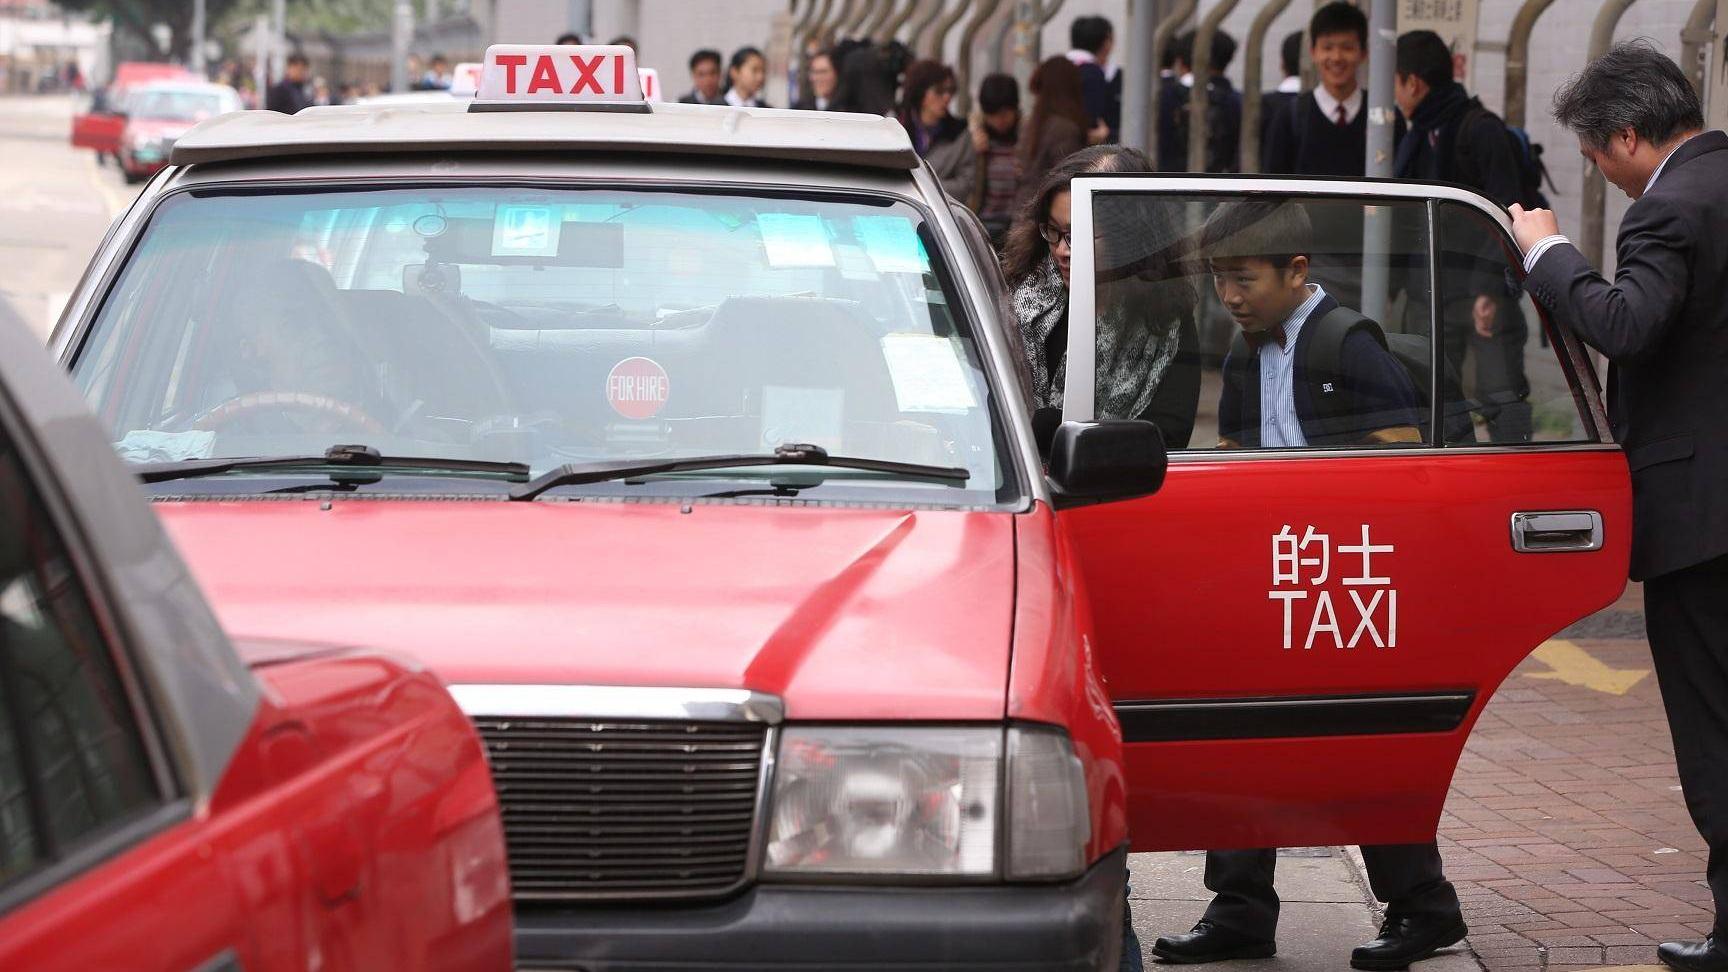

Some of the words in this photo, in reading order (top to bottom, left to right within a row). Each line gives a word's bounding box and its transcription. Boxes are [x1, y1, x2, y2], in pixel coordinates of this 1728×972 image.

[495, 55, 624, 95] TAXI
[610, 375, 634, 401] FOR
[636, 375, 665, 401] HIRE
[1272, 524, 1394, 586] 的士
[1268, 589, 1397, 649] TAXI
